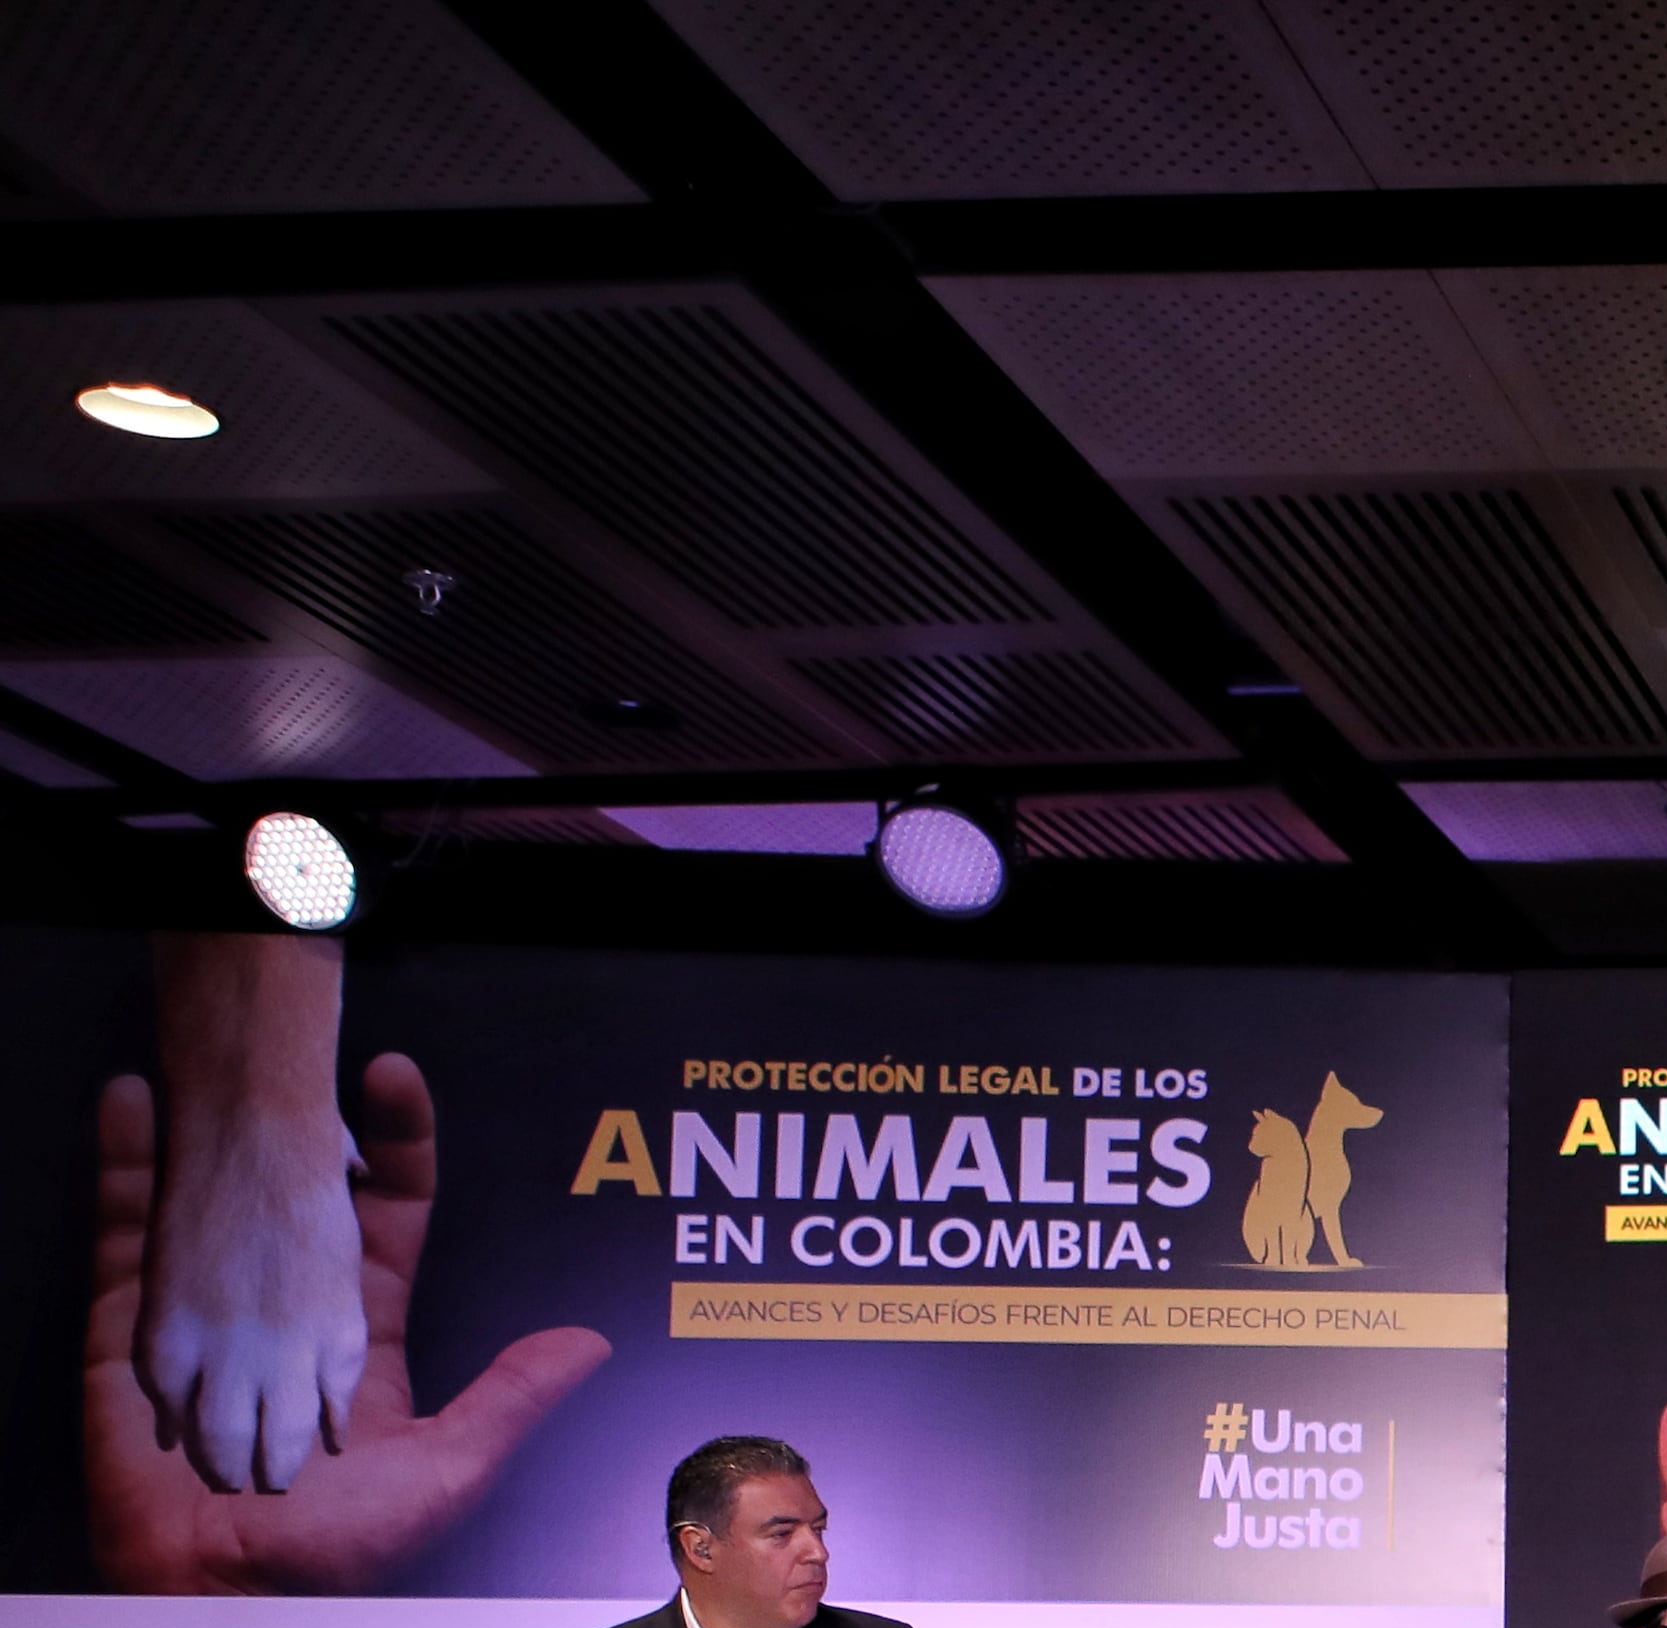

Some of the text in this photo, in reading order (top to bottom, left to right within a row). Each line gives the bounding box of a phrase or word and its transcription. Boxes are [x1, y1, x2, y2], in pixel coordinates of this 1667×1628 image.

[683, 1055, 1208, 1099] PROTECCIÓN LEGAL DE LOS
[569, 1109, 1212, 1207] ANIMALES
[675, 1214, 1172, 1271] EN COLOMBIA:
[689, 1298, 1407, 1331] AVANCES Y DESAFÍOS FRENTE AL DERECHO PENAL
[1203, 1402, 1363, 1453] #Una
[1199, 1454, 1364, 1500] Mano
[1213, 1501, 1360, 1550] Justa
